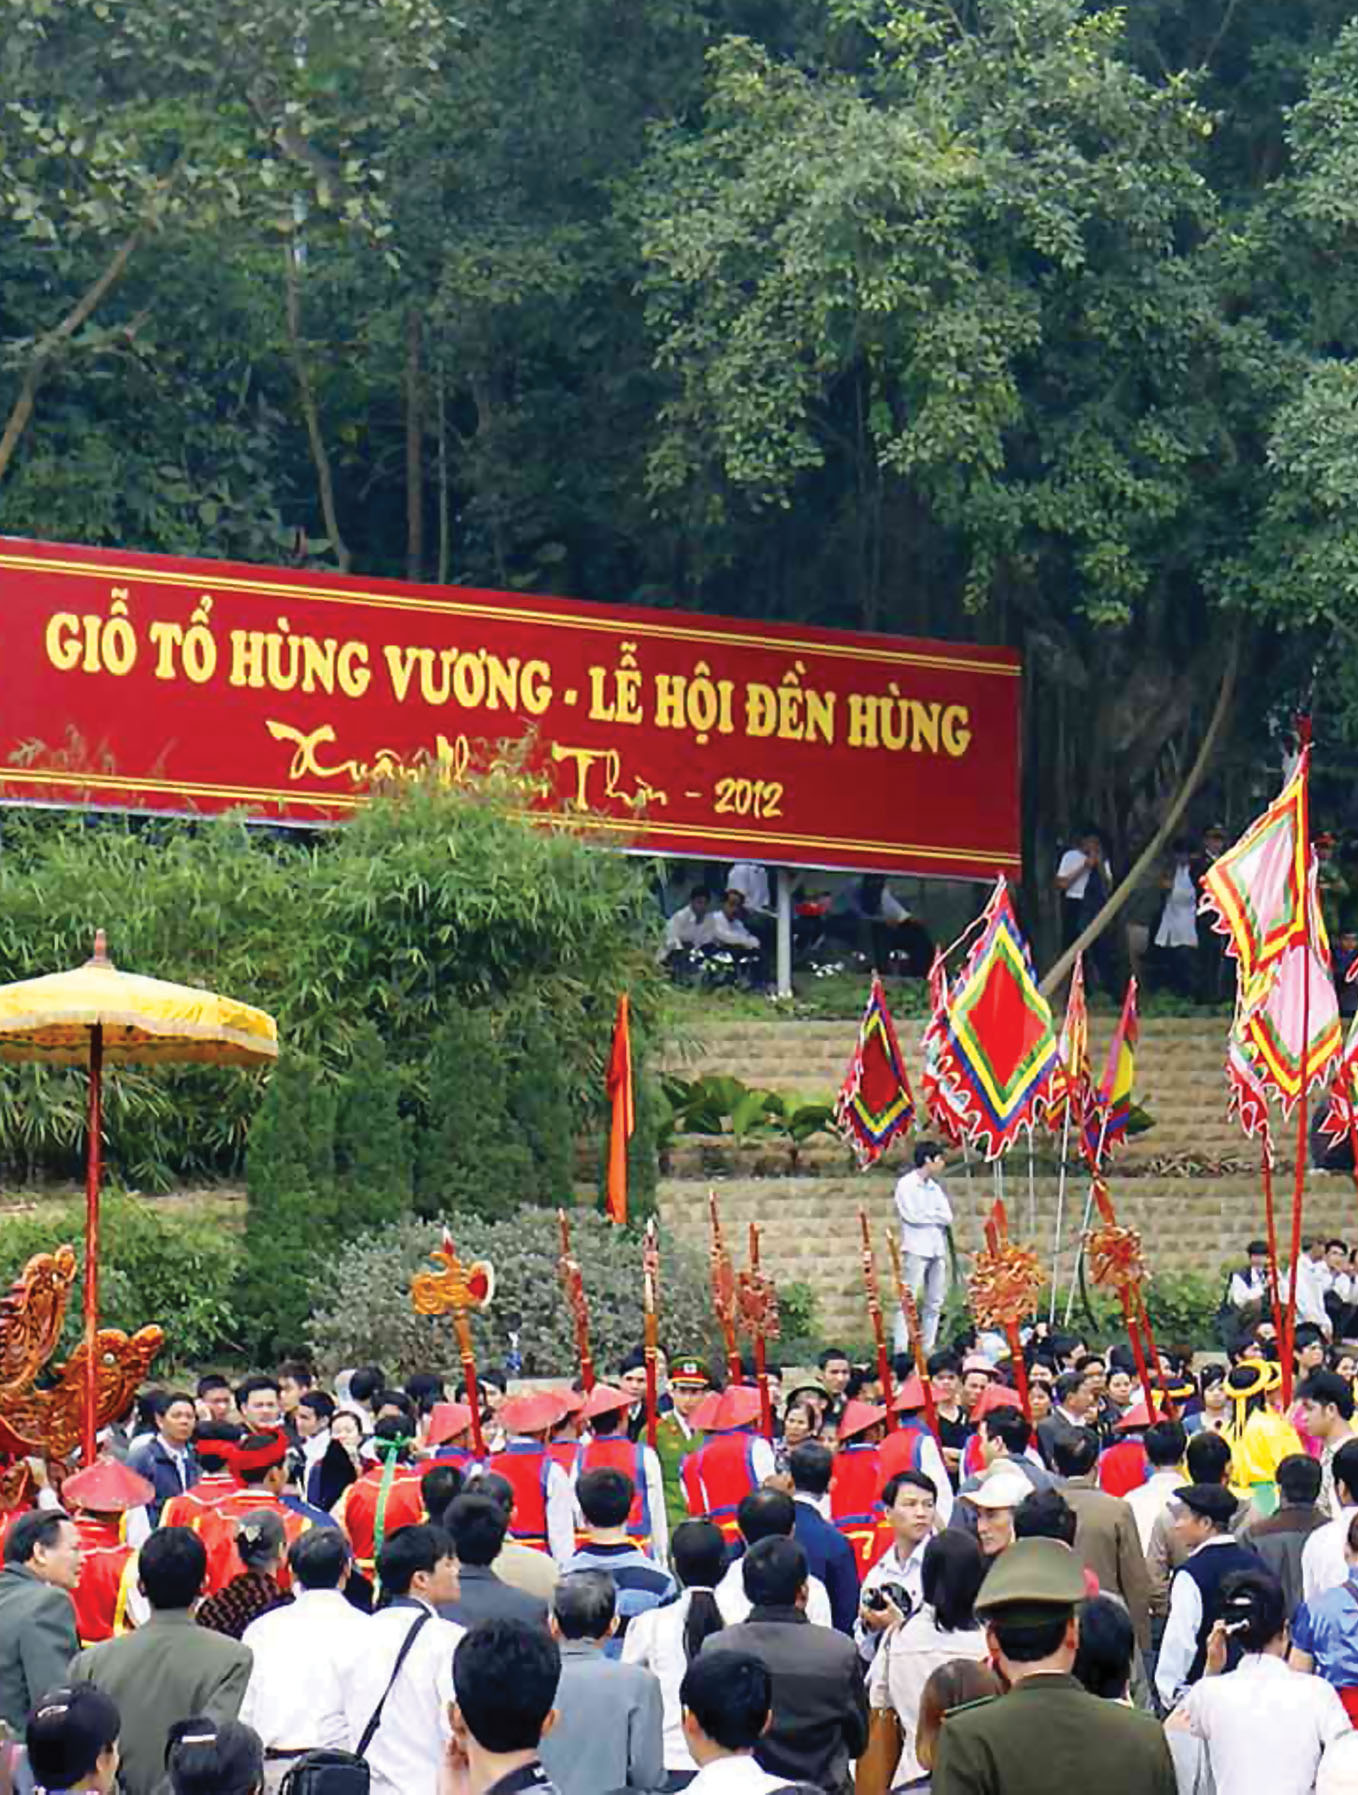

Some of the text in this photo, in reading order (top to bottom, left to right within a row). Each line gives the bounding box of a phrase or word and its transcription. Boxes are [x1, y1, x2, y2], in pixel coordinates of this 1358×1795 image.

[45, 586, 138, 677] GIỖ
[149, 595, 218, 684] TỔ
[229, 615, 372, 698] HÙNG
[383, 644, 553, 715] VƯƠNG
[588, 641, 644, 725] LỄ
[654, 660, 735, 744] HỘI
[745, 660, 836, 744] ĐỀN
[847, 682, 972, 757] HÙNG
[714, 777, 784, 819] 2012
